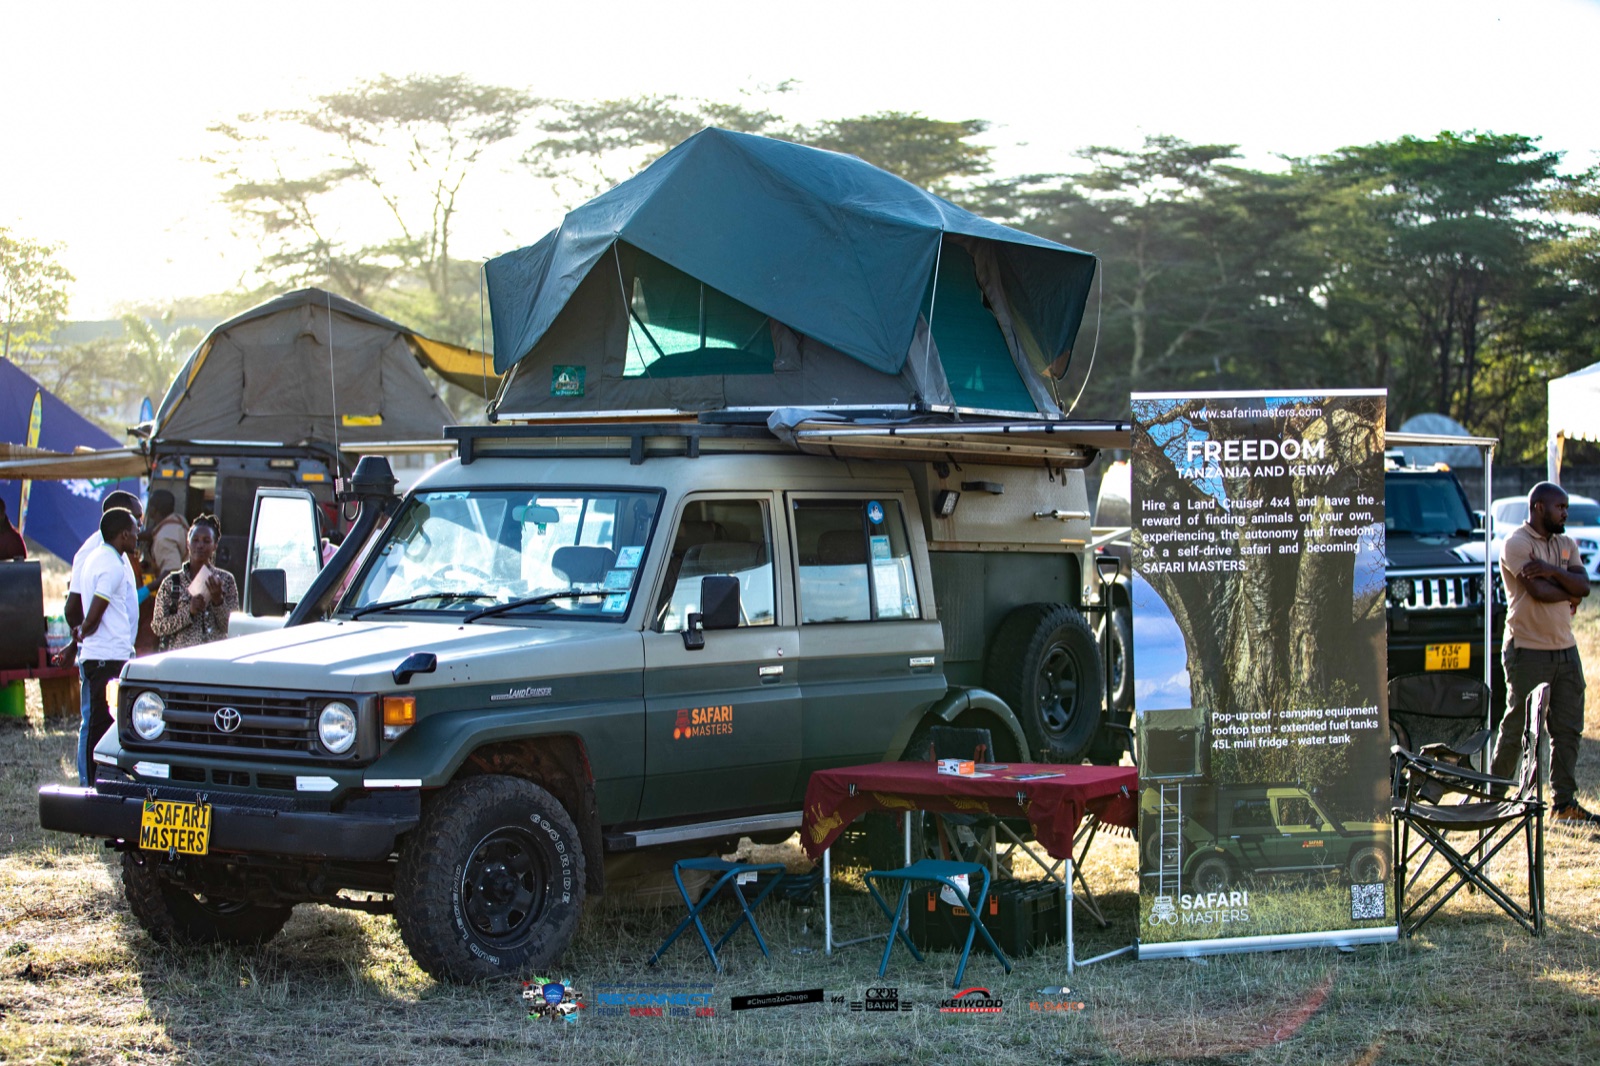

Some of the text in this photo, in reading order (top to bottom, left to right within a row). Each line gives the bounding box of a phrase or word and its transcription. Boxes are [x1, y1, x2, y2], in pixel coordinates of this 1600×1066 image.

[1190, 406, 1322, 420] www.safarimasters.com
[1187, 438, 1325, 462] FREEDOM
[1176, 464, 1336, 479] TANZANIA AND KENYA
[1142, 494, 1374, 511] Hire a Land Cruiser 4x4 and have the
[1142, 512, 1374, 526] reward of finding animals on your own,
[1142, 525, 1374, 544] experiencing the autonomy and freedom
[1143, 547, 1154, 558] of
[1163, 549, 1169, 557] a
[1178, 545, 1231, 557] self-drive
[1241, 544, 1271, 555] safari
[1279, 543, 1298, 553] and
[1307, 541, 1360, 553] becoming
[1143, 560, 1248, 573] SAFARI MASTERS.
[1442, 645, 1459, 656] 634
[1441, 658, 1459, 669] AVG
[692, 705, 733, 725] SAFARI
[1212, 712, 1248, 723] Pop-up
[1251, 709, 1272, 719] roof
[1280, 707, 1323, 719] camping
[1325, 705, 1378, 718] equipment
[692, 723, 733, 737] MASTERS
[1212, 724, 1249, 736] rooftop
[1251, 724, 1271, 734] tent
[1281, 721, 1327, 732] extended
[1330, 720, 1348, 730] fuel
[1351, 719, 1378, 729] tanks
[1212, 739, 1230, 749] 45L
[1234, 738, 1256, 748] mini
[1259, 737, 1288, 749] fridge
[1298, 736, 1326, 745] water
[1328, 734, 1351, 744] tank
[154, 804, 207, 828] SAFARI
[140, 826, 204, 852] MASTERS
[530, 814, 571, 903] GOODRIDE
[1181, 891, 1248, 910] SAFARI
[453, 864, 499, 965] MUD LEGEND
[1182, 908, 1250, 925] MASTERS
